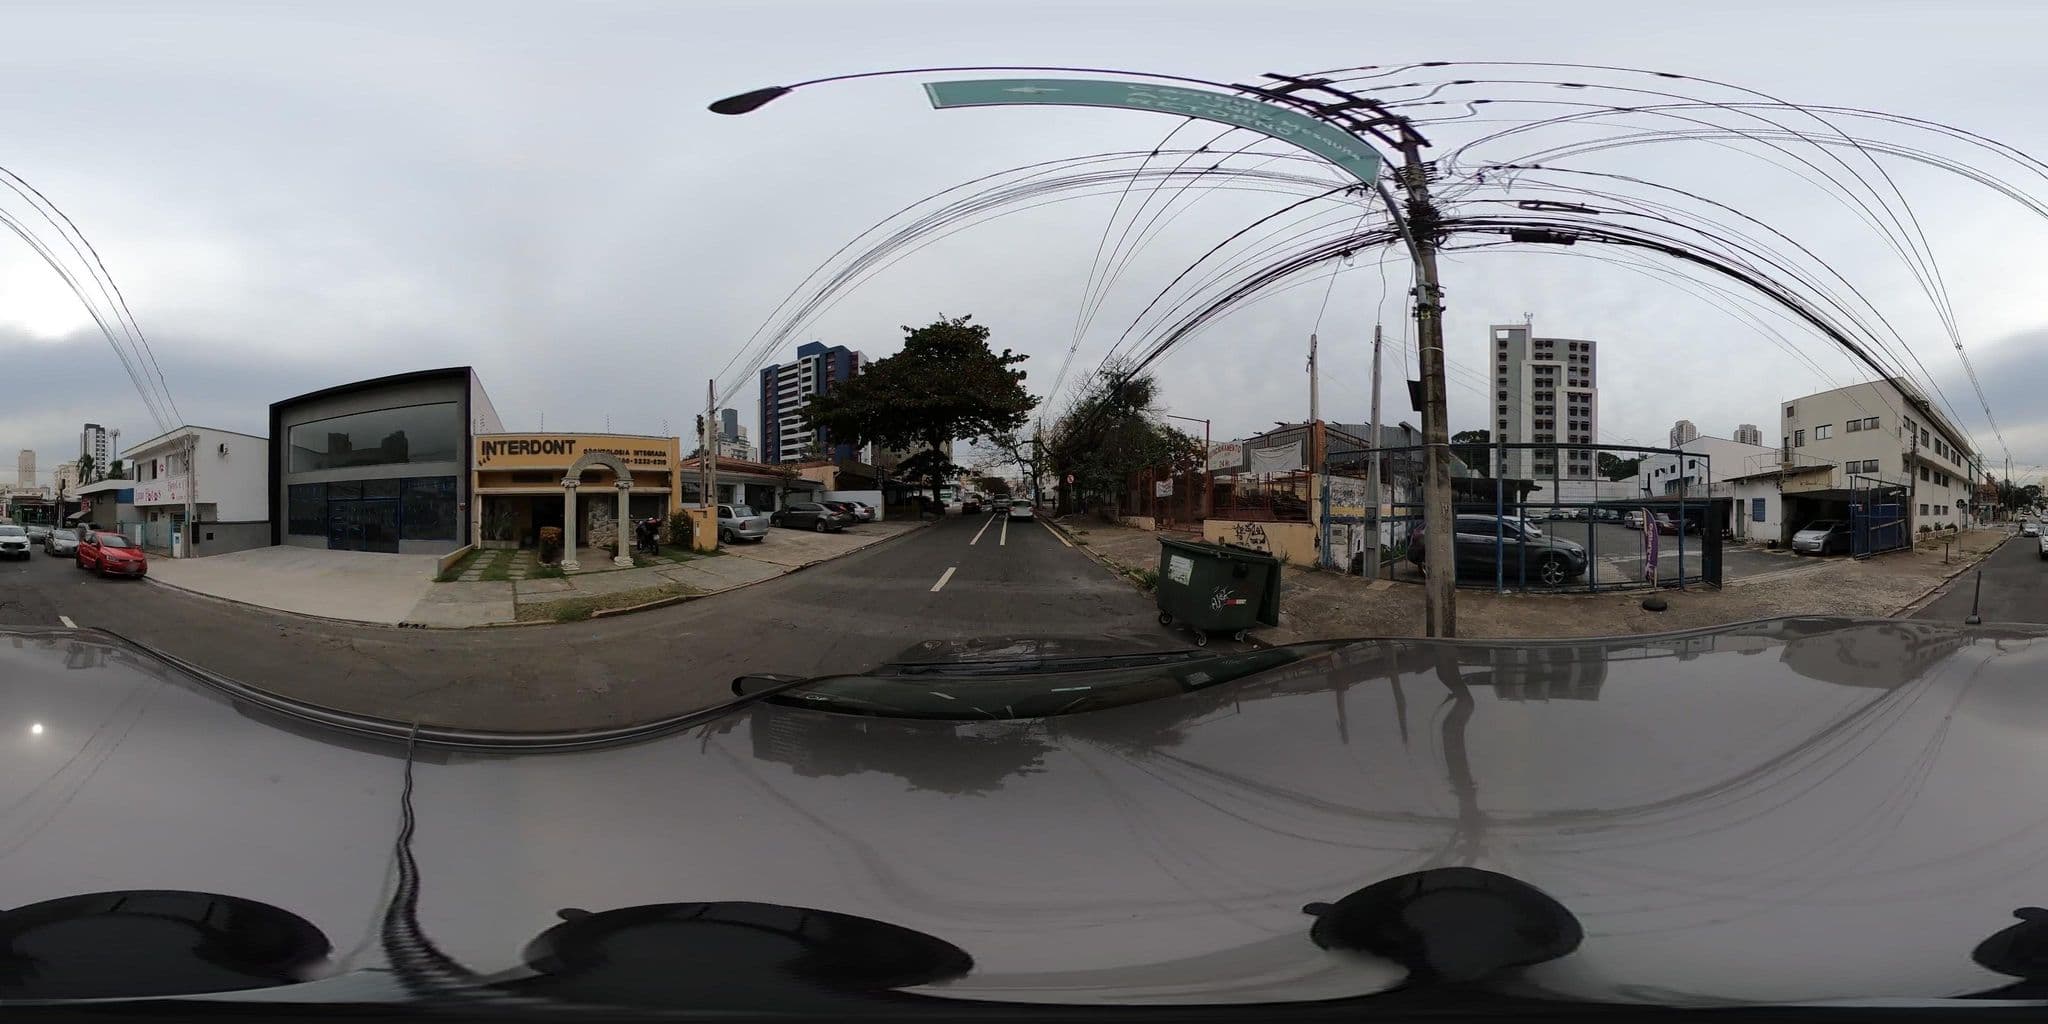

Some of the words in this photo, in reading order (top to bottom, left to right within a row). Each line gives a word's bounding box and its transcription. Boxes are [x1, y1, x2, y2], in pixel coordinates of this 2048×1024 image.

[1125, 97, 1292, 136] RETORNO
[481, 439, 576, 455] INTERDONT
[633, 449, 667, 457] INTEGRADA
